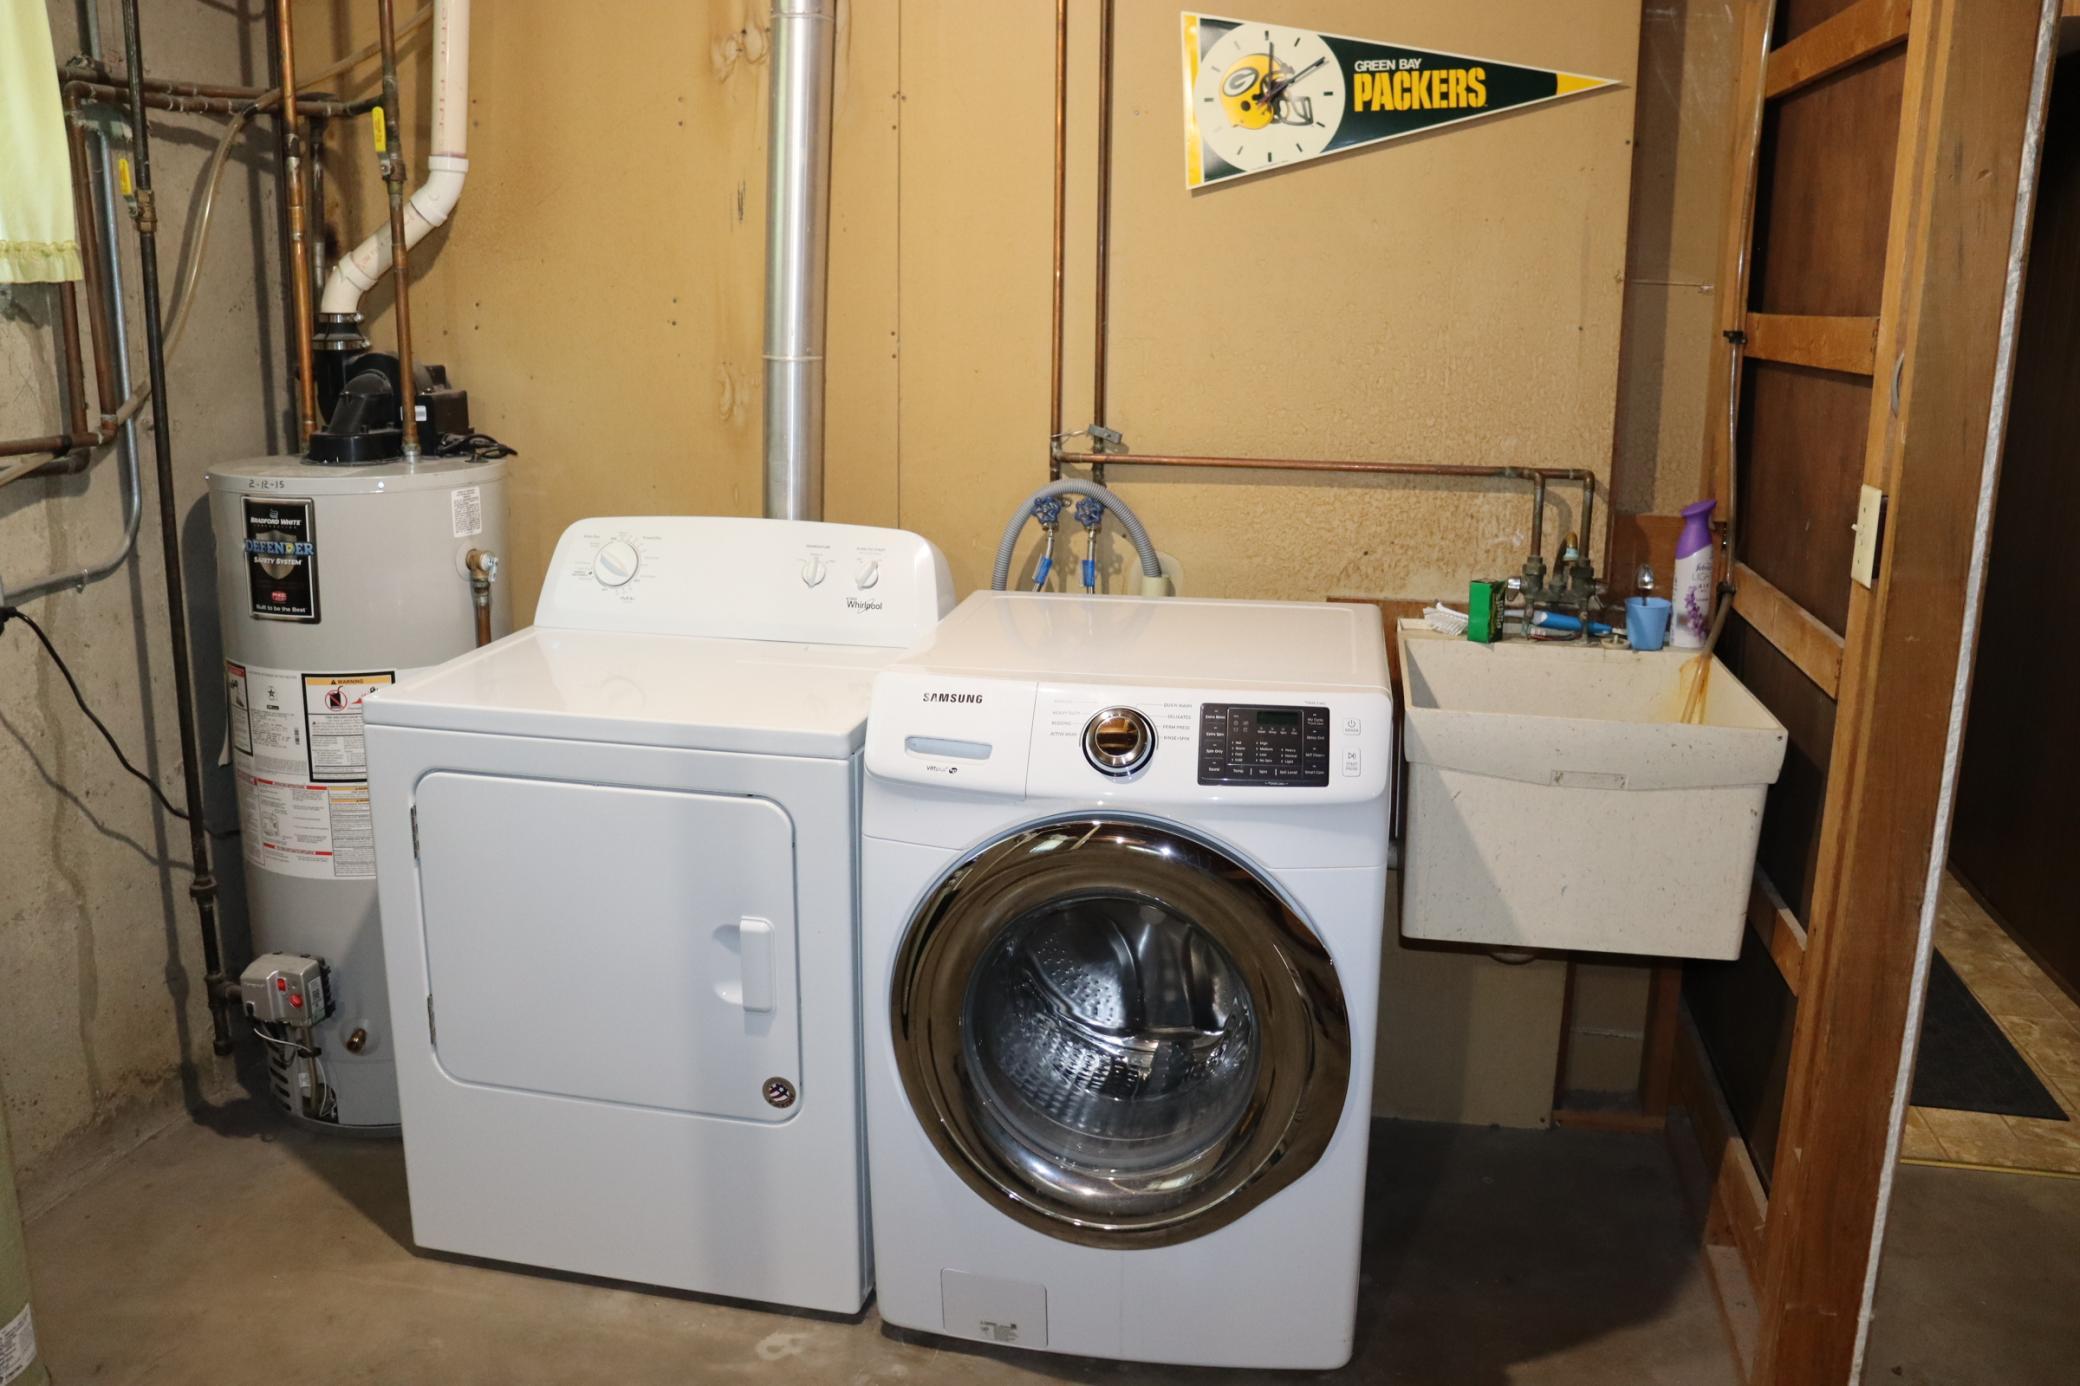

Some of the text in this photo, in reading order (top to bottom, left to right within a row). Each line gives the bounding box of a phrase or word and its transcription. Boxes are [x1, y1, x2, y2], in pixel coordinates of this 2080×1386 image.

[1354, 58, 1422, 72] GREEN BAY
[1354, 67, 1486, 112] PACKERS
[249, 480, 285, 489] 2-12-15
[245, 538, 314, 556] DEFENDER
[275, 558, 302, 566] SYSTEM
[846, 600, 883, 612] Whirlpool
[923, 692, 984, 704] SAMSUNG
